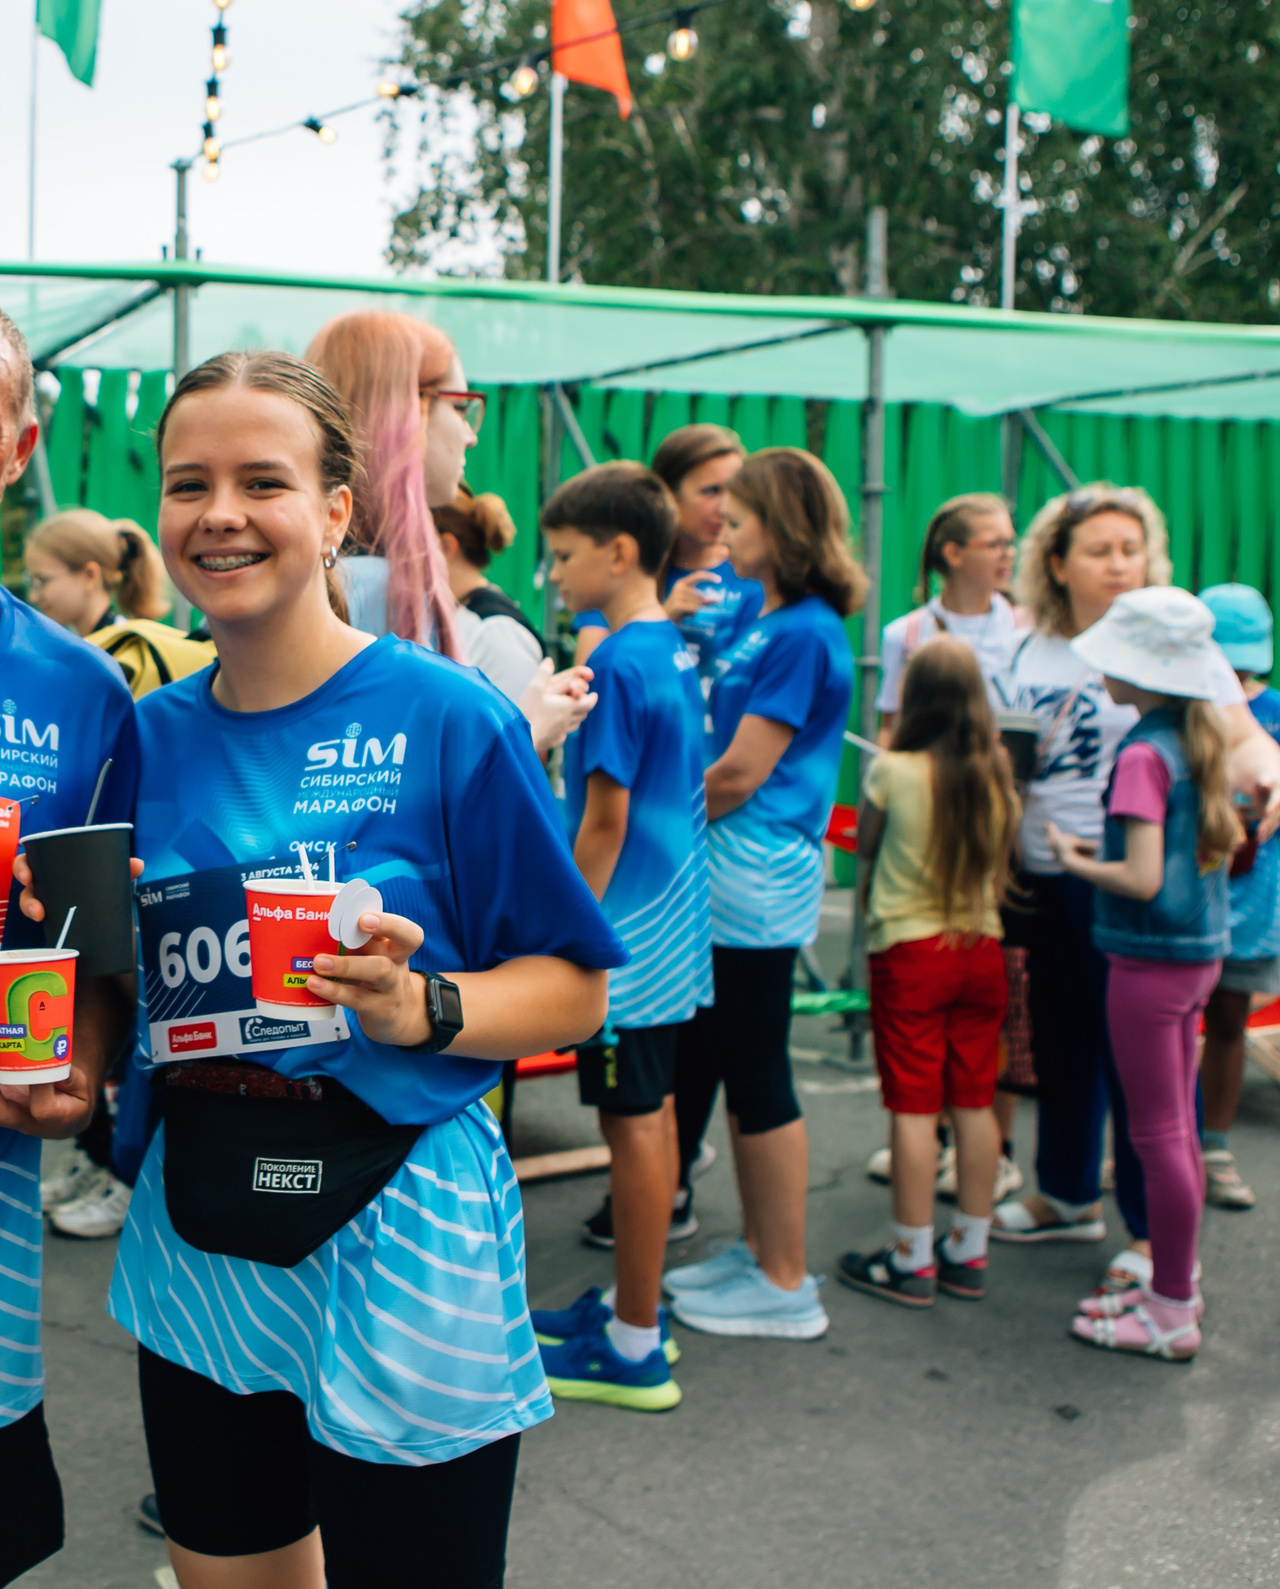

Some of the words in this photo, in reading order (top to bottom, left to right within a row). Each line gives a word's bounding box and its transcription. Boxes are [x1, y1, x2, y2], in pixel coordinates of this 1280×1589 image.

[300, 767, 402, 788] СИБИРСКИЙ
[293, 796, 397, 815] МАРАФОН
[289, 841, 338, 852] ОМСК
[248, 866, 293, 880] АВГУСТА
[294, 862, 320, 873] 24
[252, 903, 293, 921] Альфа
[252, 1022, 305, 1037] Следопыт
[260, 1162, 317, 1174] ПОКОЛЕНИЕ
[257, 1171, 317, 1190] НЕКСТ
